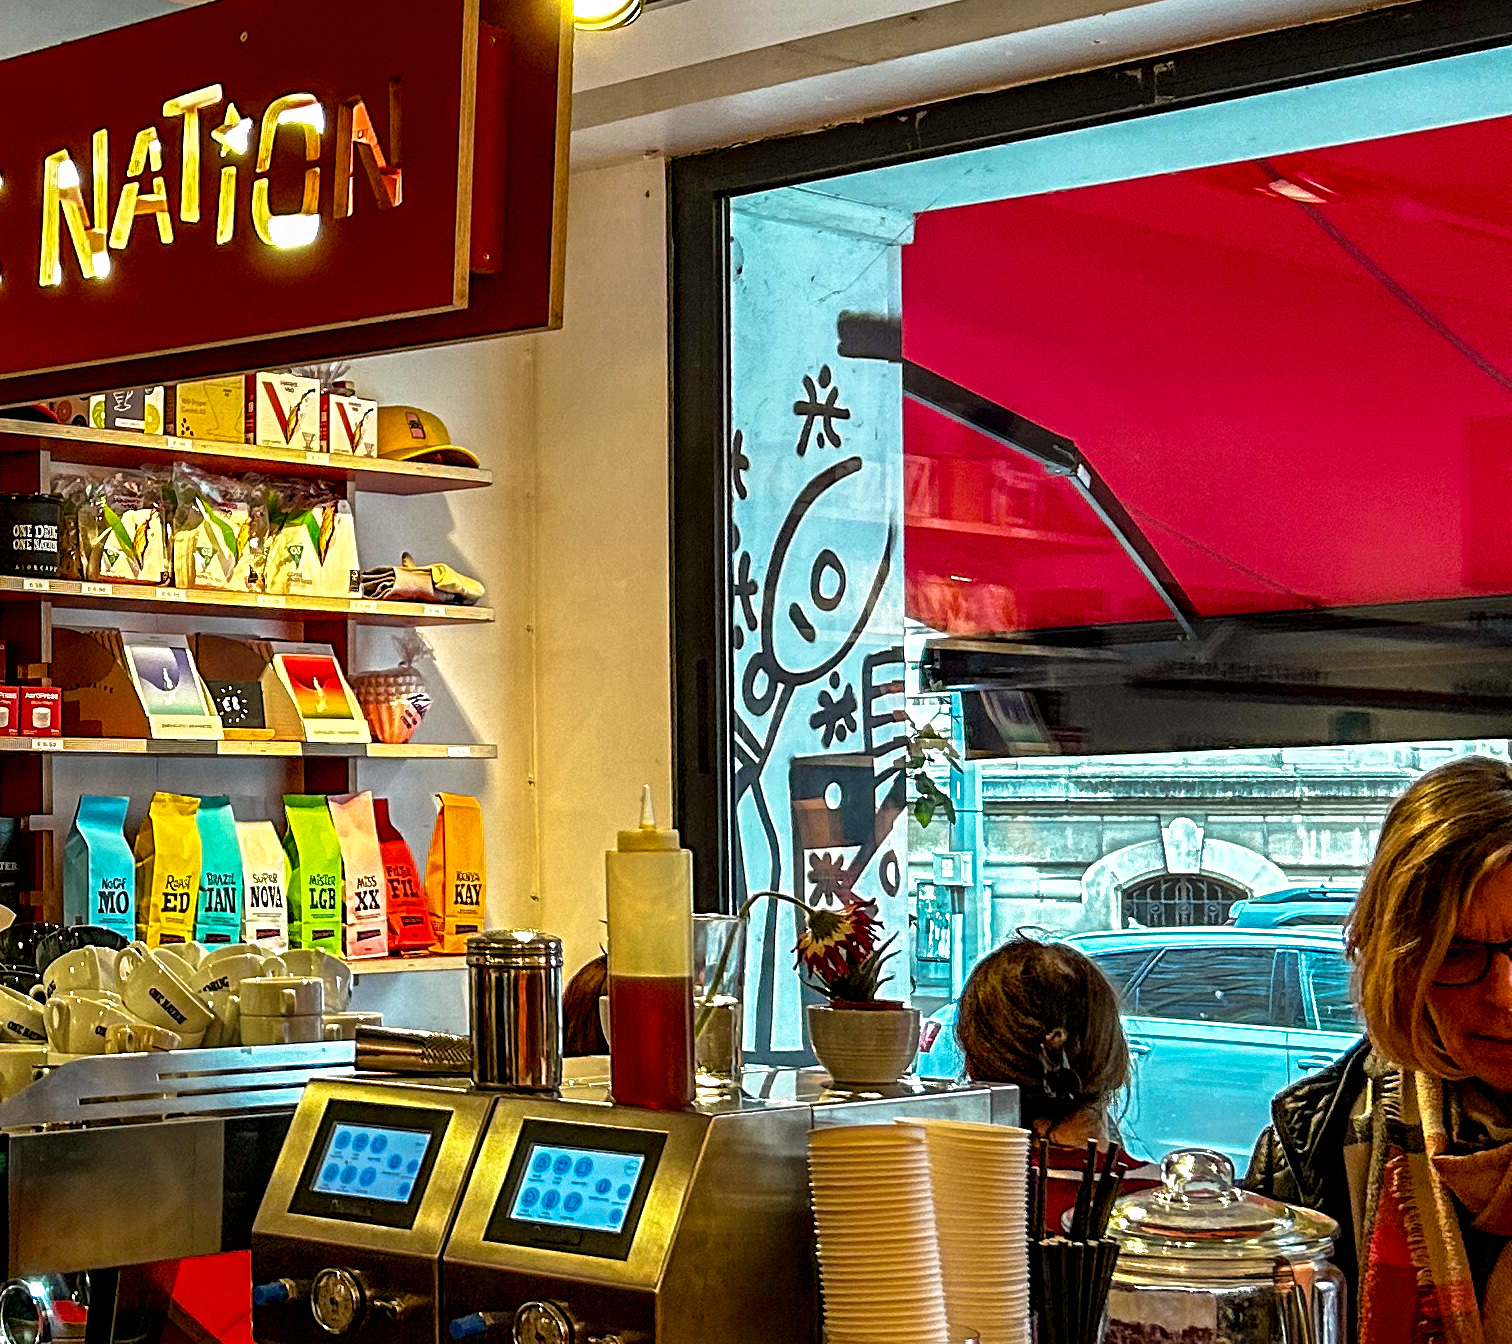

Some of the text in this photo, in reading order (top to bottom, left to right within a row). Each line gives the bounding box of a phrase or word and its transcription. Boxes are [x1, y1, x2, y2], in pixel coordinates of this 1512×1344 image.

[39, 76, 403, 287] NATION
[13, 524, 33, 538] ONE
[13, 538, 33, 551] ONE
[206, 872, 236, 886] BRAZIL
[386, 878, 421, 899] FIL
[98, 891, 130, 914] MO
[161, 892, 191, 914] ED
[205, 887, 237, 913] IAN
[250, 886, 284, 909] NOVA
[309, 887, 336, 910] LGB
[354, 888, 381, 912] XX
[454, 883, 483, 906] KAY
